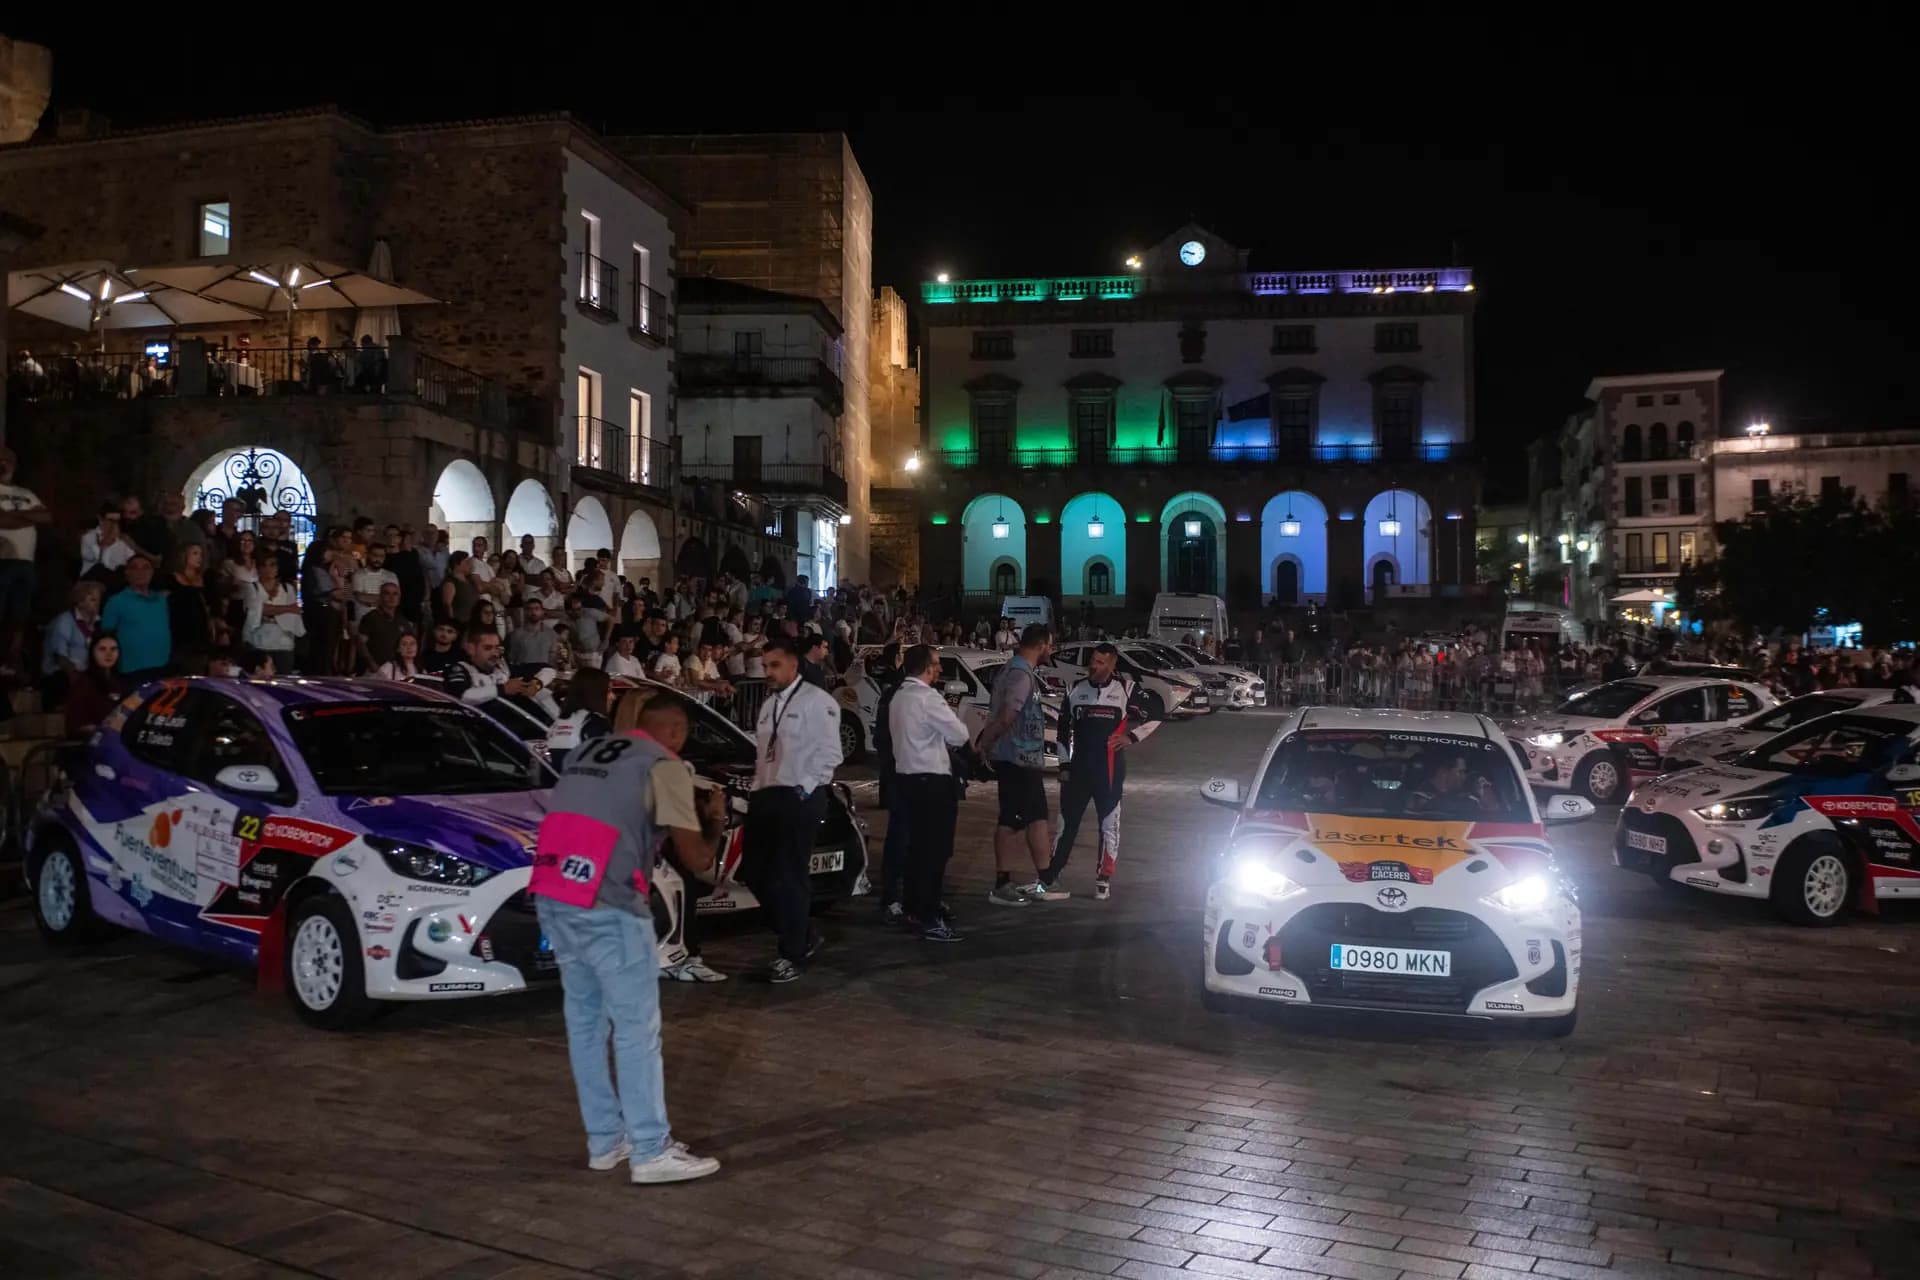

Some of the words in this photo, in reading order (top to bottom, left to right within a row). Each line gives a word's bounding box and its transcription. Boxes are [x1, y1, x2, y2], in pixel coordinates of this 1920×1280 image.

[577, 739, 632, 764] 18
[1389, 733, 1479, 749] KOBEMOTOR
[239, 815, 260, 841] 22
[275, 824, 335, 849] KOBEMOTOR
[1315, 828, 1458, 849] lasertek
[114, 822, 198, 889] Fuerteventura
[407, 884, 470, 897] KOBEMOTOR
[1346, 949, 1398, 970] 0980
[1406, 952, 1446, 973] MKN
[432, 983, 482, 991] KUMHO
[1261, 987, 1295, 997] KUMHO
[1487, 1001, 1522, 1010] KUMHO
